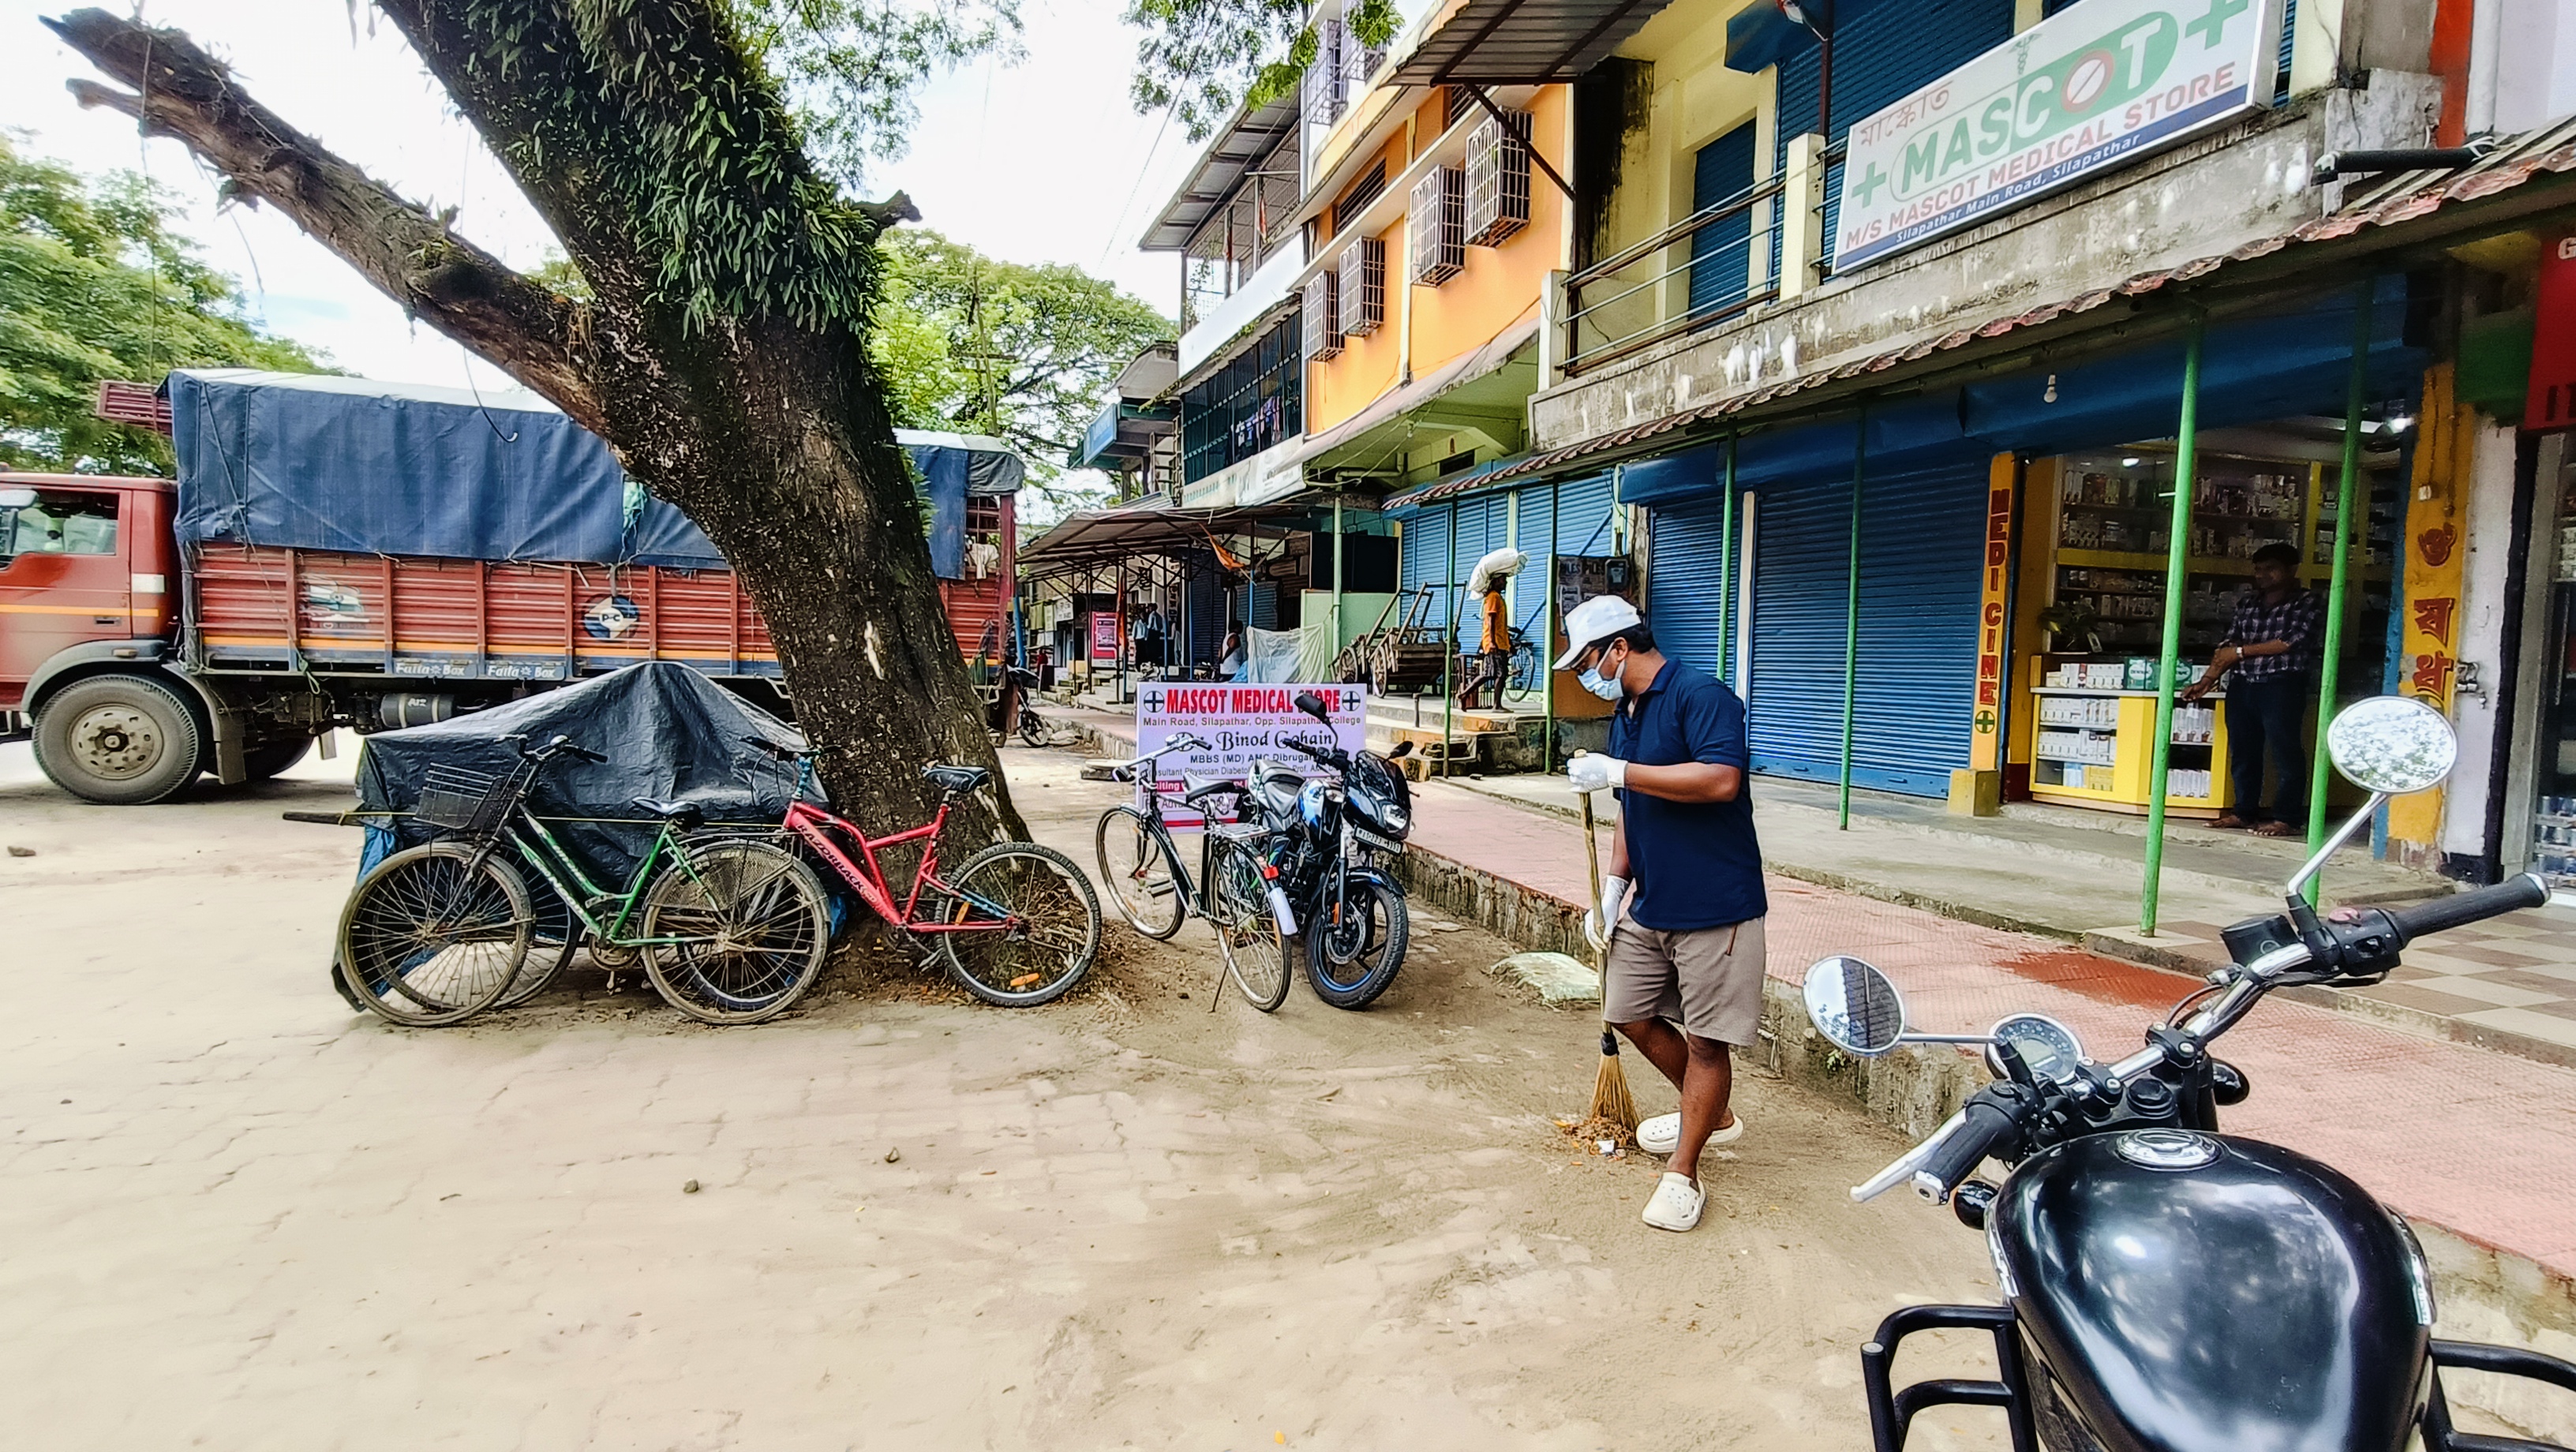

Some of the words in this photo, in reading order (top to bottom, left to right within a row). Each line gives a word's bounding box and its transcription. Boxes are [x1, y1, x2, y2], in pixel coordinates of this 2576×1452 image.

[1901, 17, 2162, 193] MASCOT
[1845, 219, 1881, 249] M/S
[1889, 175, 1980, 230] MASCOT
[1987, 119, 2112, 189] MEDICAL
[2124, 61, 2235, 130] STORE
[1896, 208, 1962, 243] Silapathar
[1965, 192, 1999, 215] Main
[2005, 171, 2047, 198] Road,
[2053, 133, 2140, 178] Silapathar
[1979, 488, 2010, 706] MEDICINE
[443, 664, 465, 676] Box
[534, 666, 556, 679] Box
[1166, 689, 1227, 714] MASCOT
[1232, 689, 1293, 714] MEDICAL
[1144, 717, 1166, 726] Main
[1170, 717, 1198, 727] Road,
[1201, 717, 1251, 728] Silapathar,
[1255, 717, 1276, 727] Opp.
[1279, 716, 1327, 727] Silapatha
[1328, 716, 1361, 726] College
[1216, 731, 1270, 751] Binod
[1190, 754, 1219, 764] MBBS
[1222, 754, 1245, 765] (MD)
[1273, 753, 1314, 765] Dibrugar
